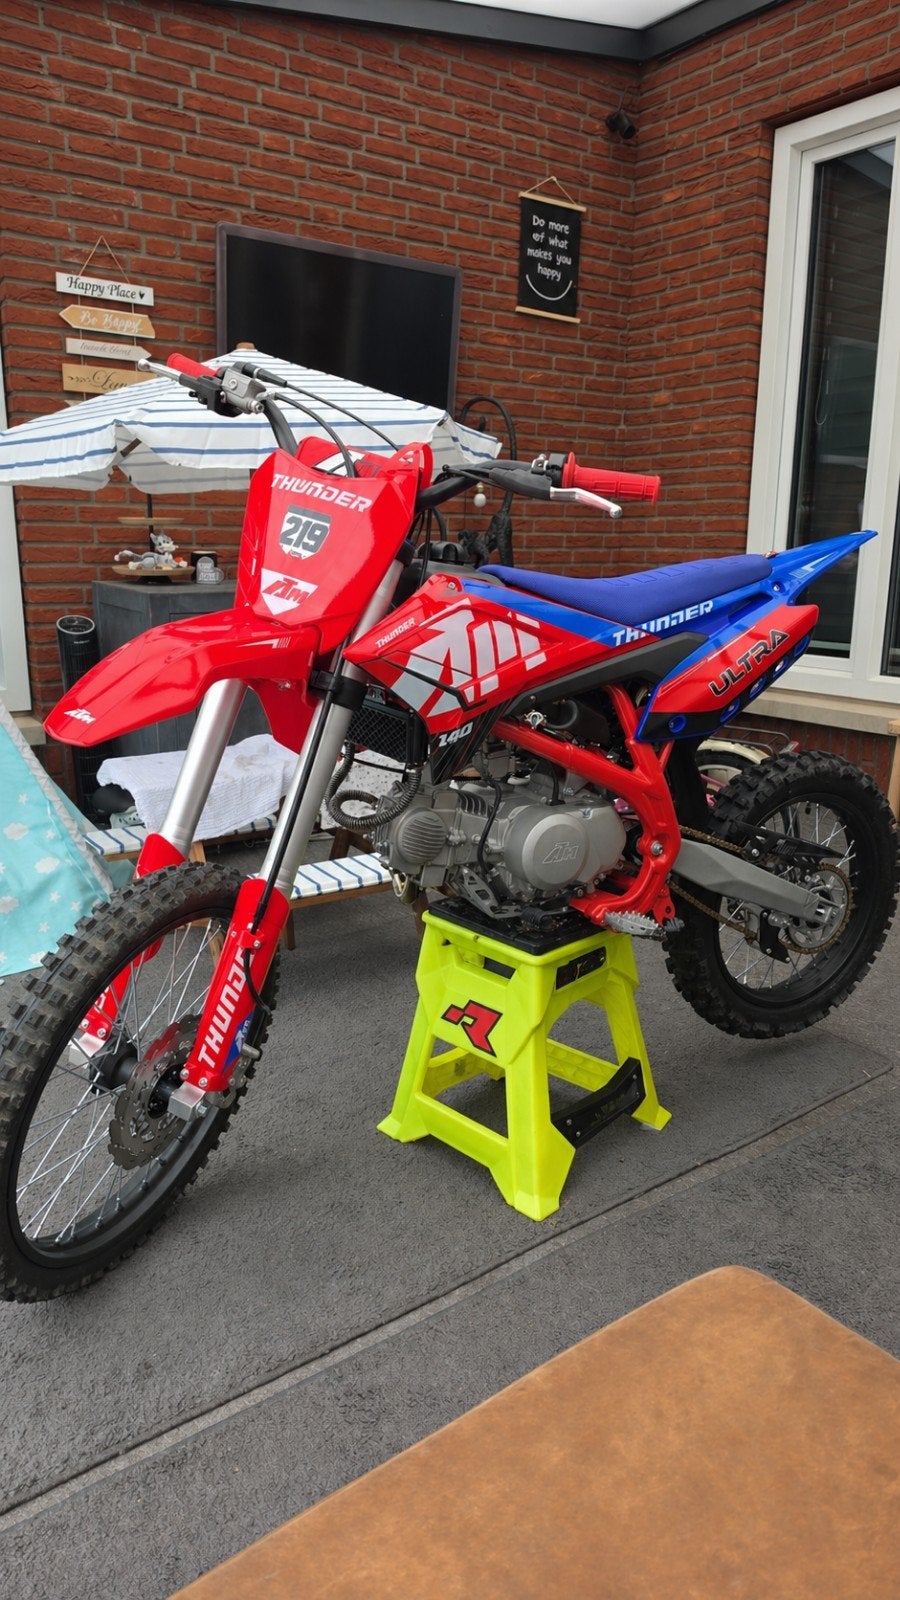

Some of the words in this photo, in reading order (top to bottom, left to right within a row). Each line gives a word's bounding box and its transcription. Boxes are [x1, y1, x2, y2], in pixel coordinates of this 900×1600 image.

[532, 214, 546, 227] Do
[548, 221, 570, 234] more
[548, 235, 569, 250] what
[527, 247, 553, 261] makes
[556, 253, 572, 266] you
[537, 262, 562, 282] happy
[67, 275, 105, 296] Happy
[107, 284, 137, 299] Place
[270, 473, 373, 513] THUNDER
[280, 515, 330, 554] 219
[375, 617, 416, 649] THUNDER
[612, 599, 715, 647] THUNDER
[708, 628, 790, 697] ULTRA
[437, 721, 474, 747] 140
